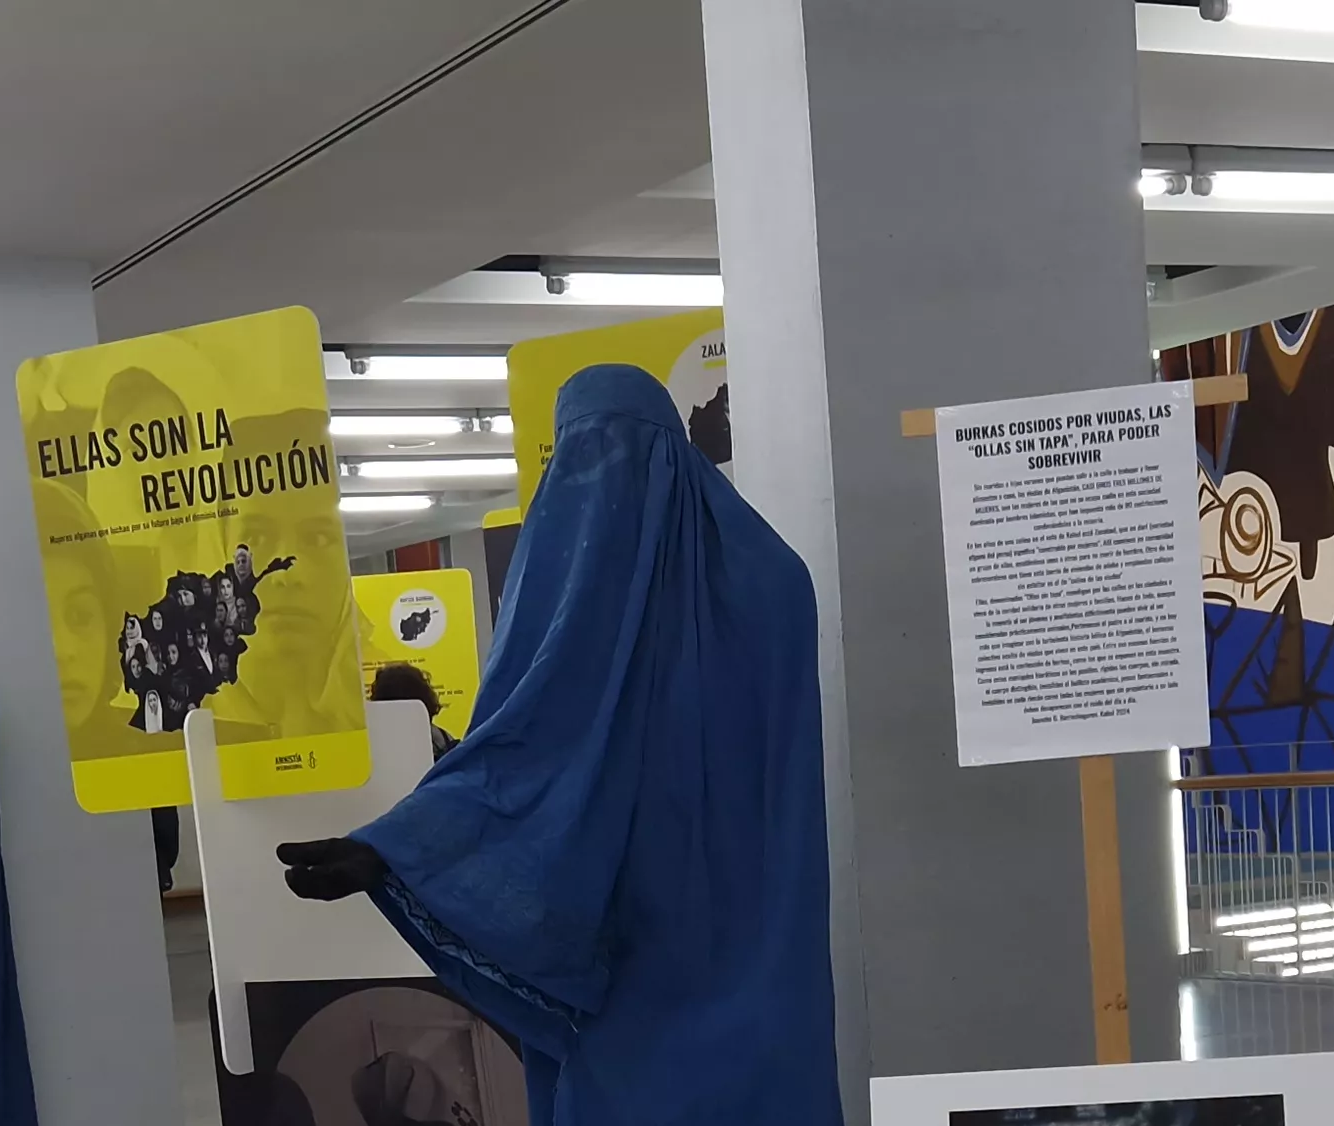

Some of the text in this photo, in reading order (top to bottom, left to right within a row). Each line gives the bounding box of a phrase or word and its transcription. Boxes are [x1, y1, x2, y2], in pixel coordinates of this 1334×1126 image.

[955, 404, 1172, 442] BURKAS COSIDOS POR VIUDAS, LAS
[1015, 437, 1035, 453] SIN
[1081, 429, 1115, 446] PARA
[1118, 424, 1160, 441] PODER
[38, 407, 234, 479] ELLAS SON LA
[1028, 449, 1102, 470] SOBREVIVIR
[141, 439, 331, 514] REVOLUCIÓN
